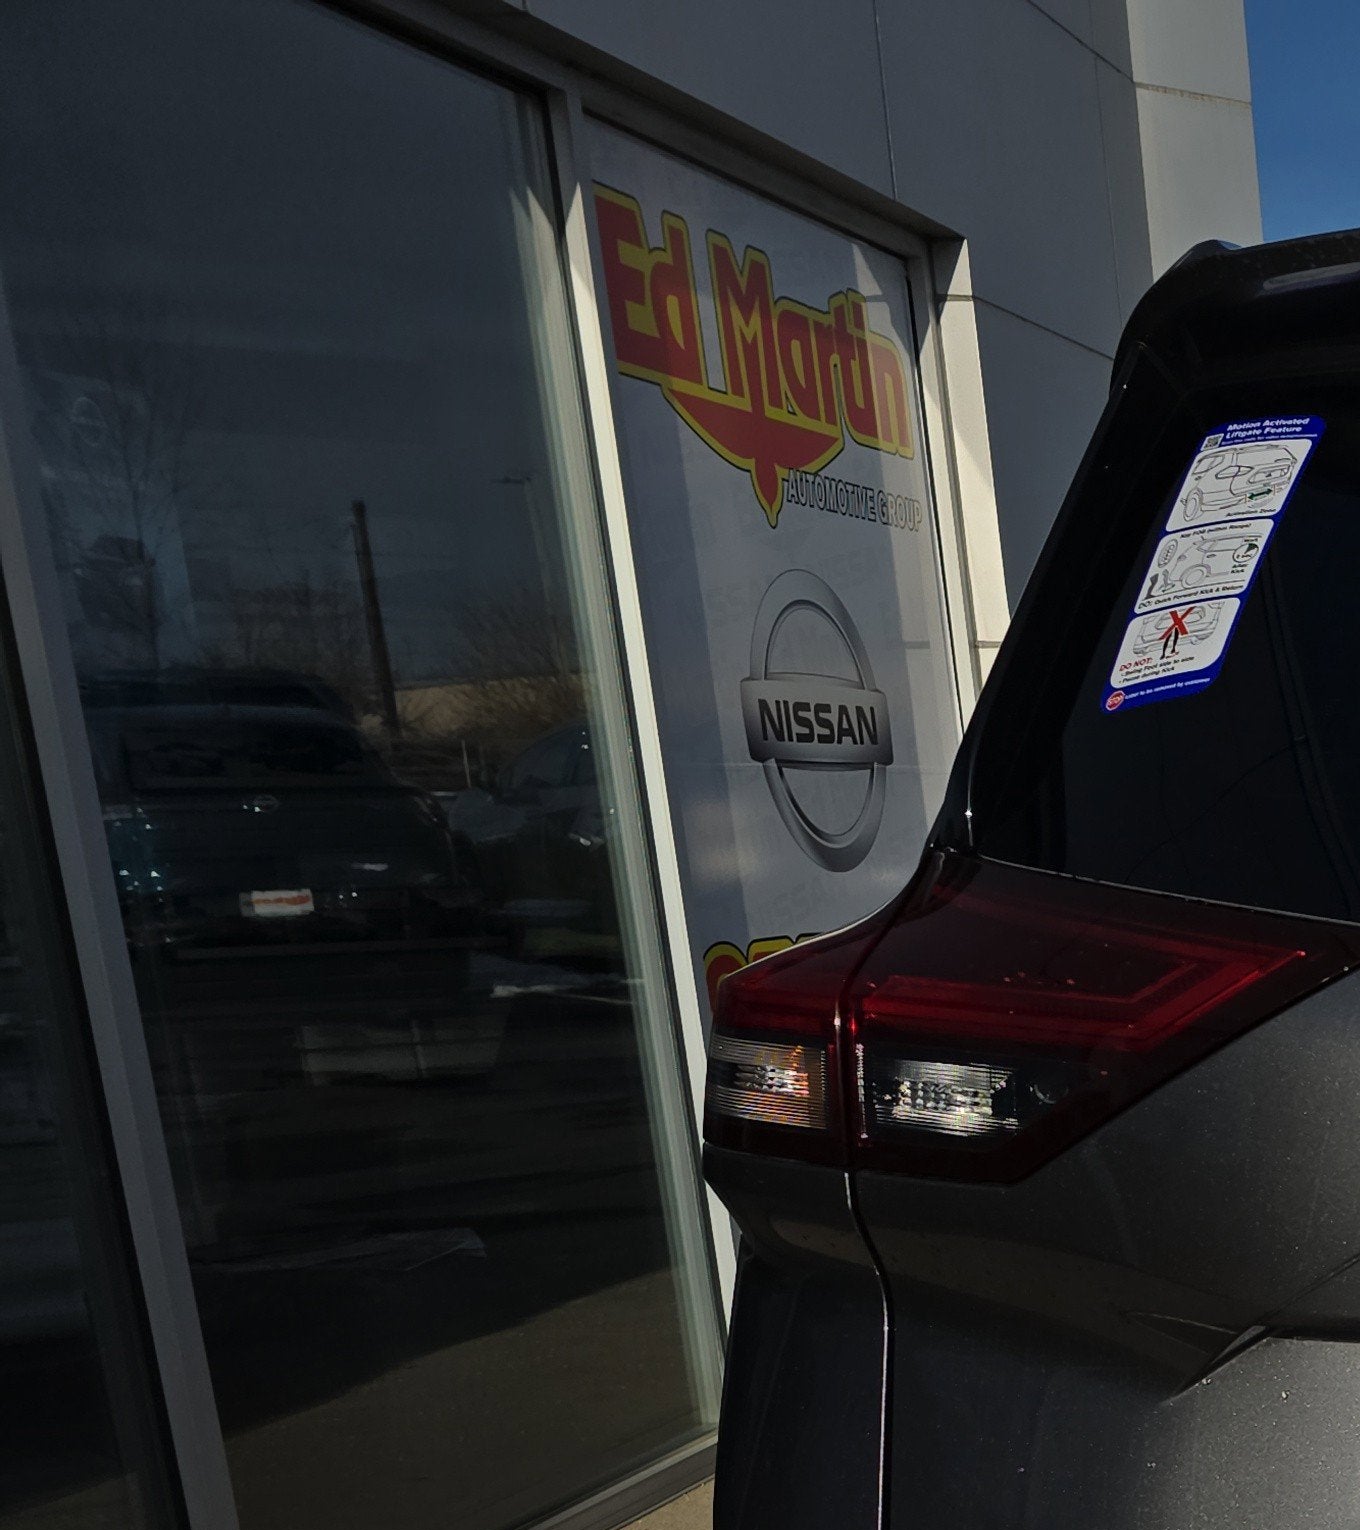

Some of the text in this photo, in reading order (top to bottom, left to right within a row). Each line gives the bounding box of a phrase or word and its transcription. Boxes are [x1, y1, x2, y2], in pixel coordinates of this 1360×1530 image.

[593, 183, 915, 459] Ed Martin
[785, 467, 923, 533] AUTOMOTIVE GROUP
[758, 697, 879, 748] NISSAN
